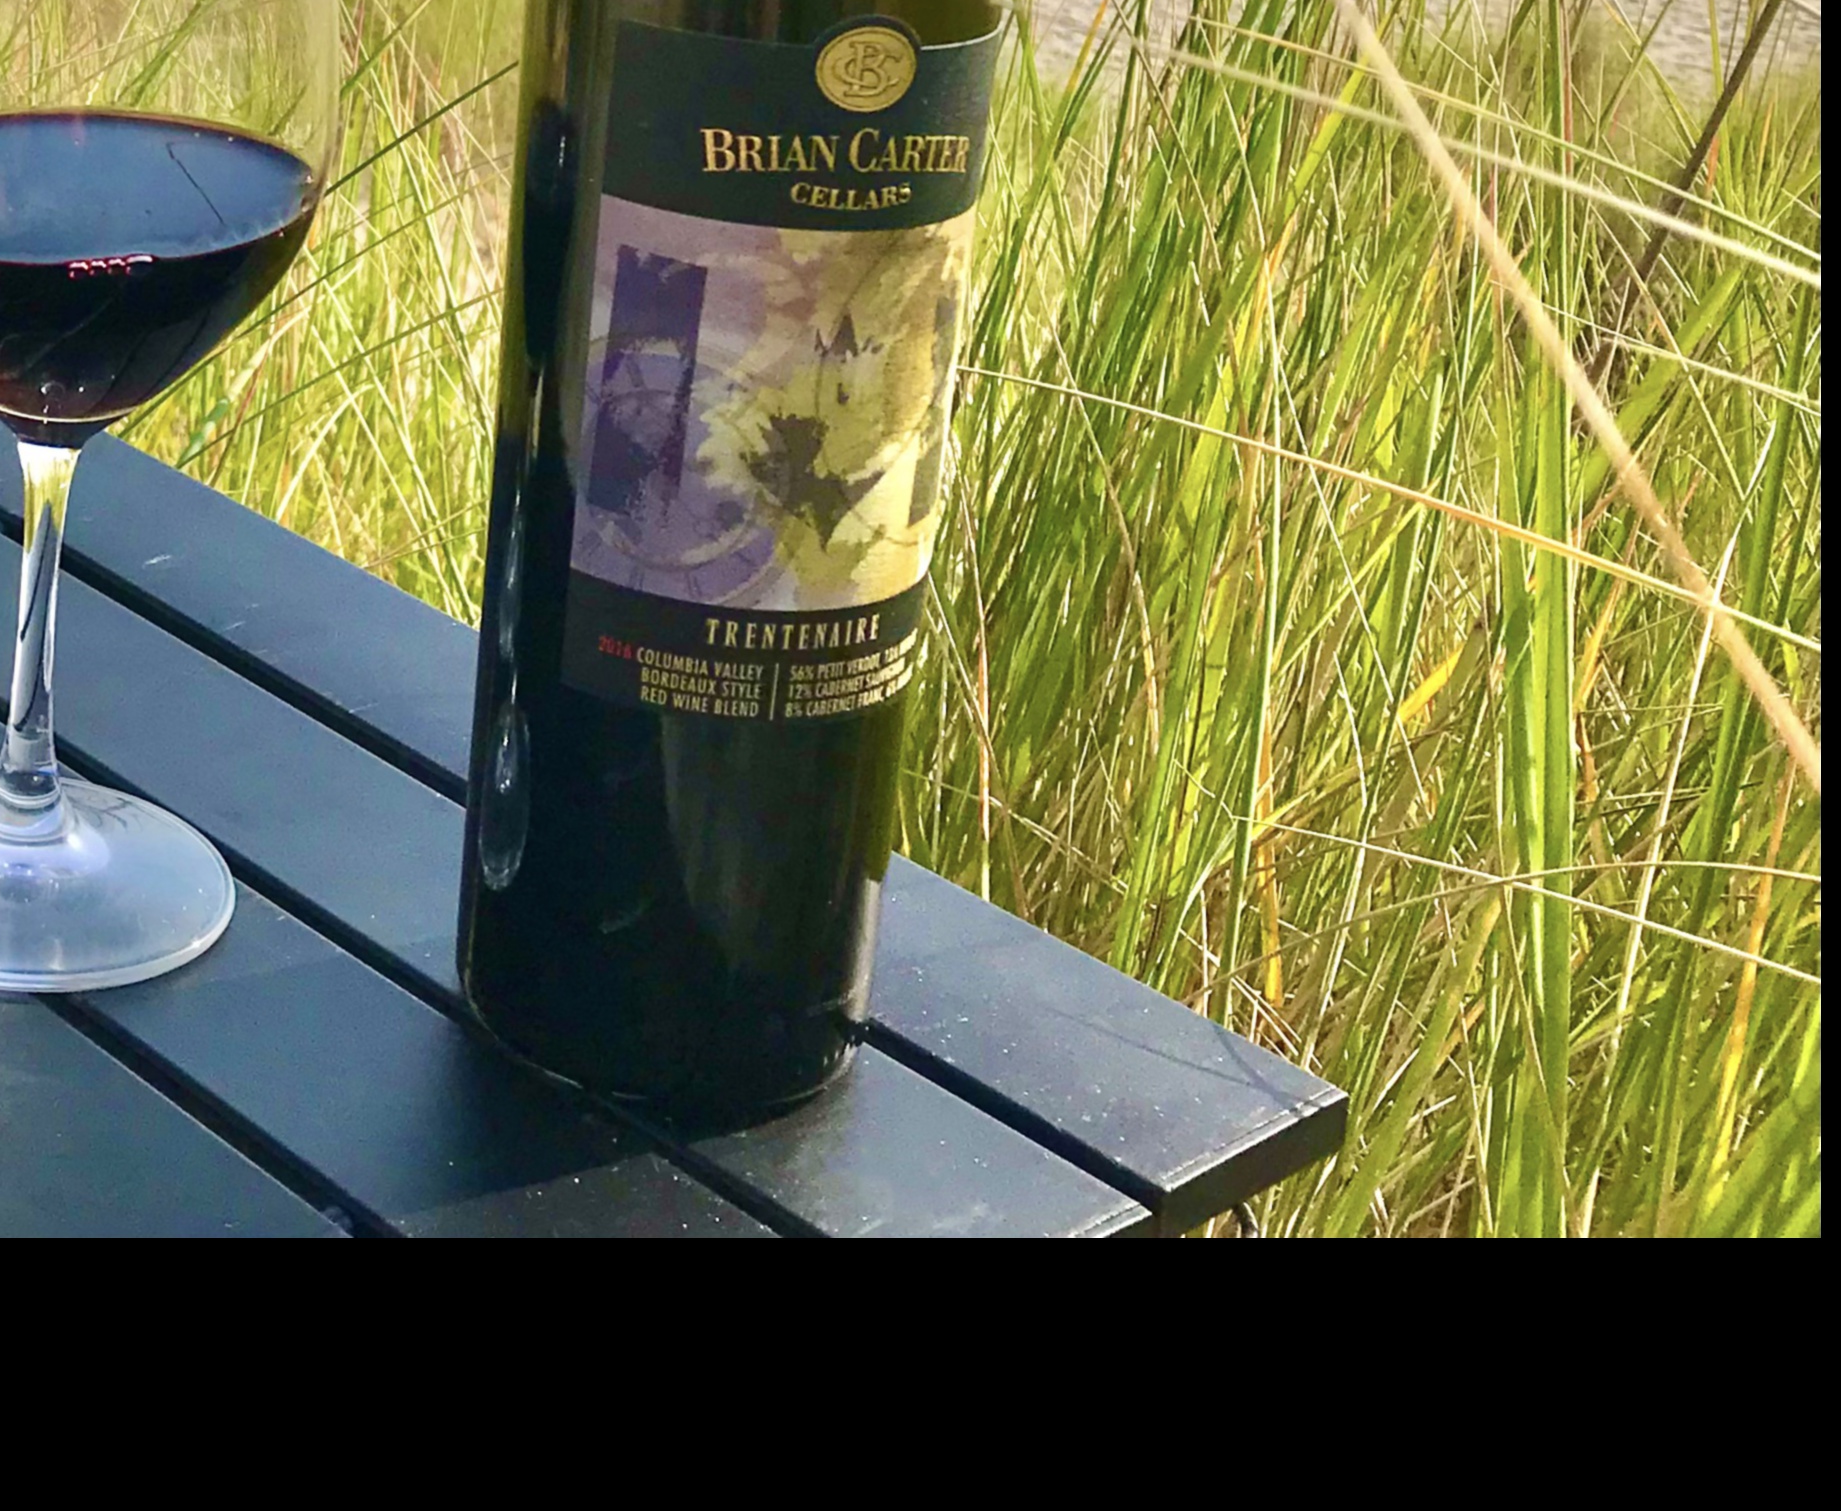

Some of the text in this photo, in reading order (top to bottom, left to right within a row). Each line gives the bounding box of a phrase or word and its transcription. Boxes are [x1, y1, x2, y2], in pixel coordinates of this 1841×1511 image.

[699, 128, 970, 173] BRIAN CARTER
[791, 182, 912, 210] CELLARS
[705, 613, 881, 650] TRENTENAIRE
[636, 646, 709, 676] COLUMBIA
[713, 662, 764, 680] VALLEY
[788, 665, 815, 682] 56%
[816, 660, 845, 679] PETIT
[640, 666, 762, 700] BORDEAUX STYLE
[640, 685, 760, 718] RED WINE BLEND
